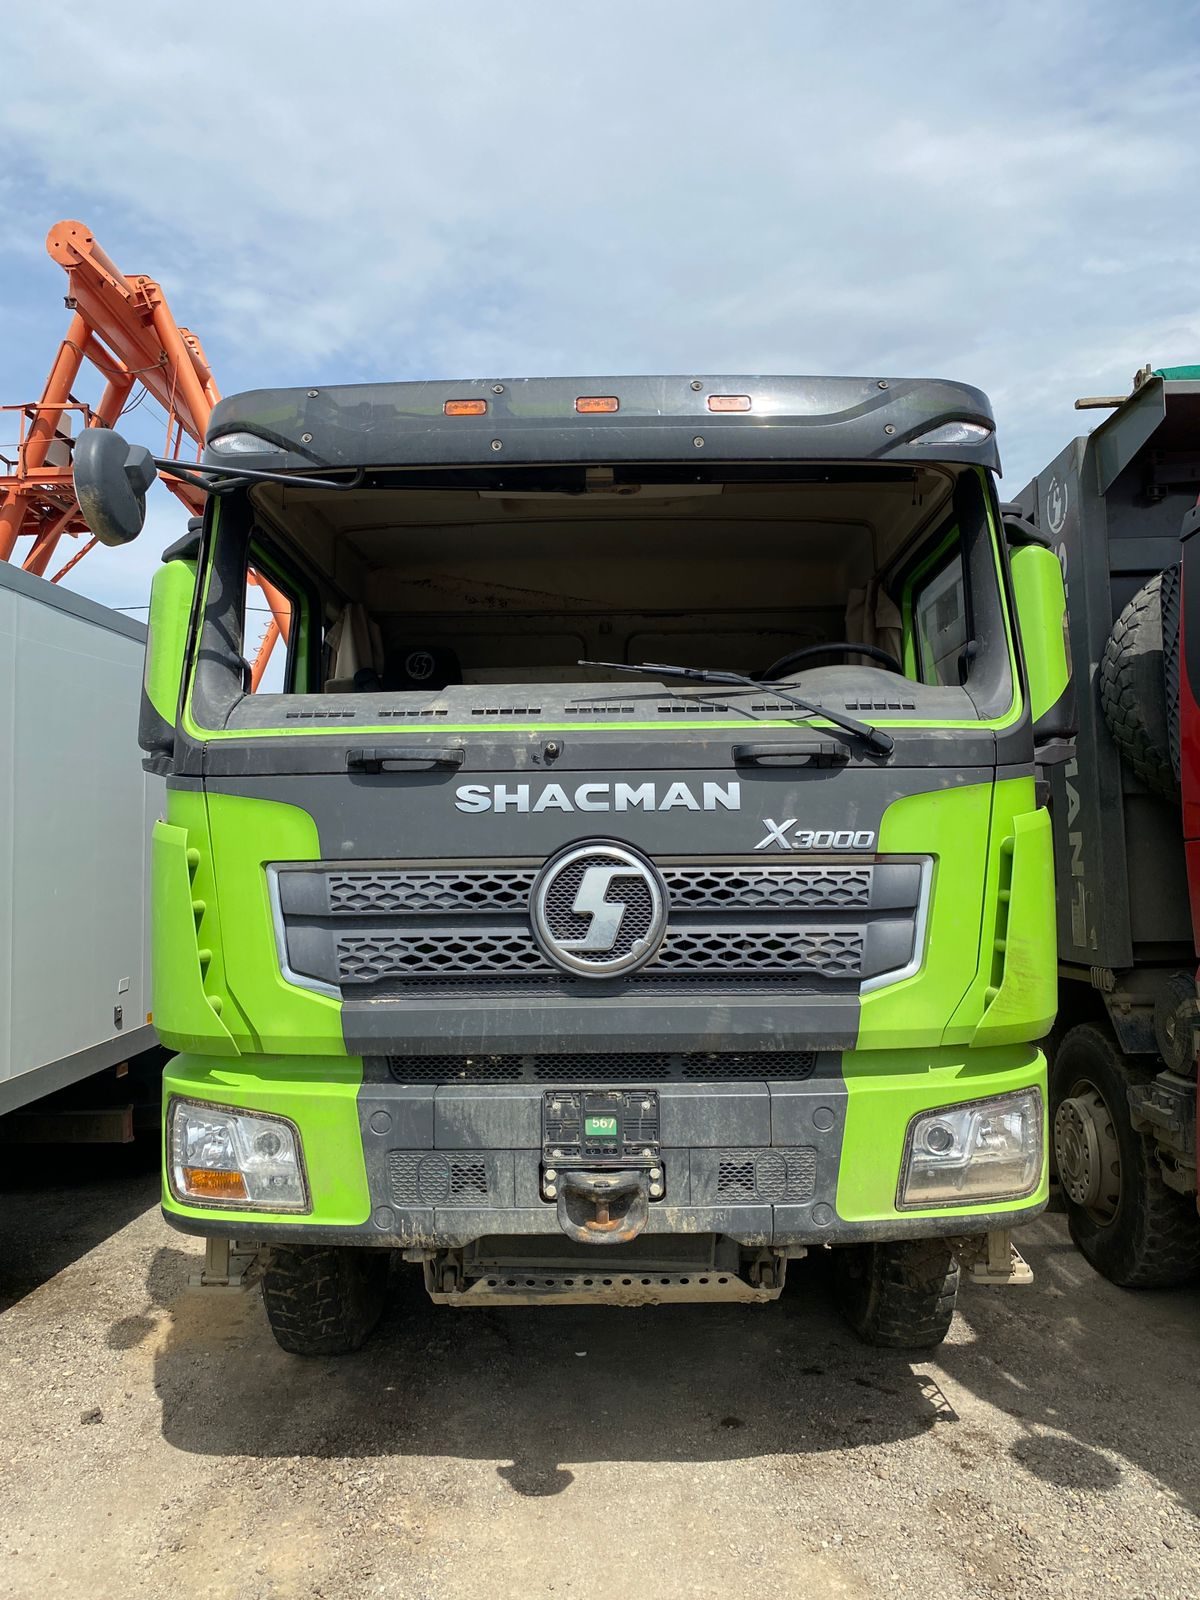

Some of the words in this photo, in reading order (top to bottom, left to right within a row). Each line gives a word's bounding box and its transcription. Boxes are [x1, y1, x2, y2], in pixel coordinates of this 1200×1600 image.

[454, 782, 741, 814] SHACMAN
[753, 818, 875, 851] X3000
[592, 1117, 615, 1128] 567
